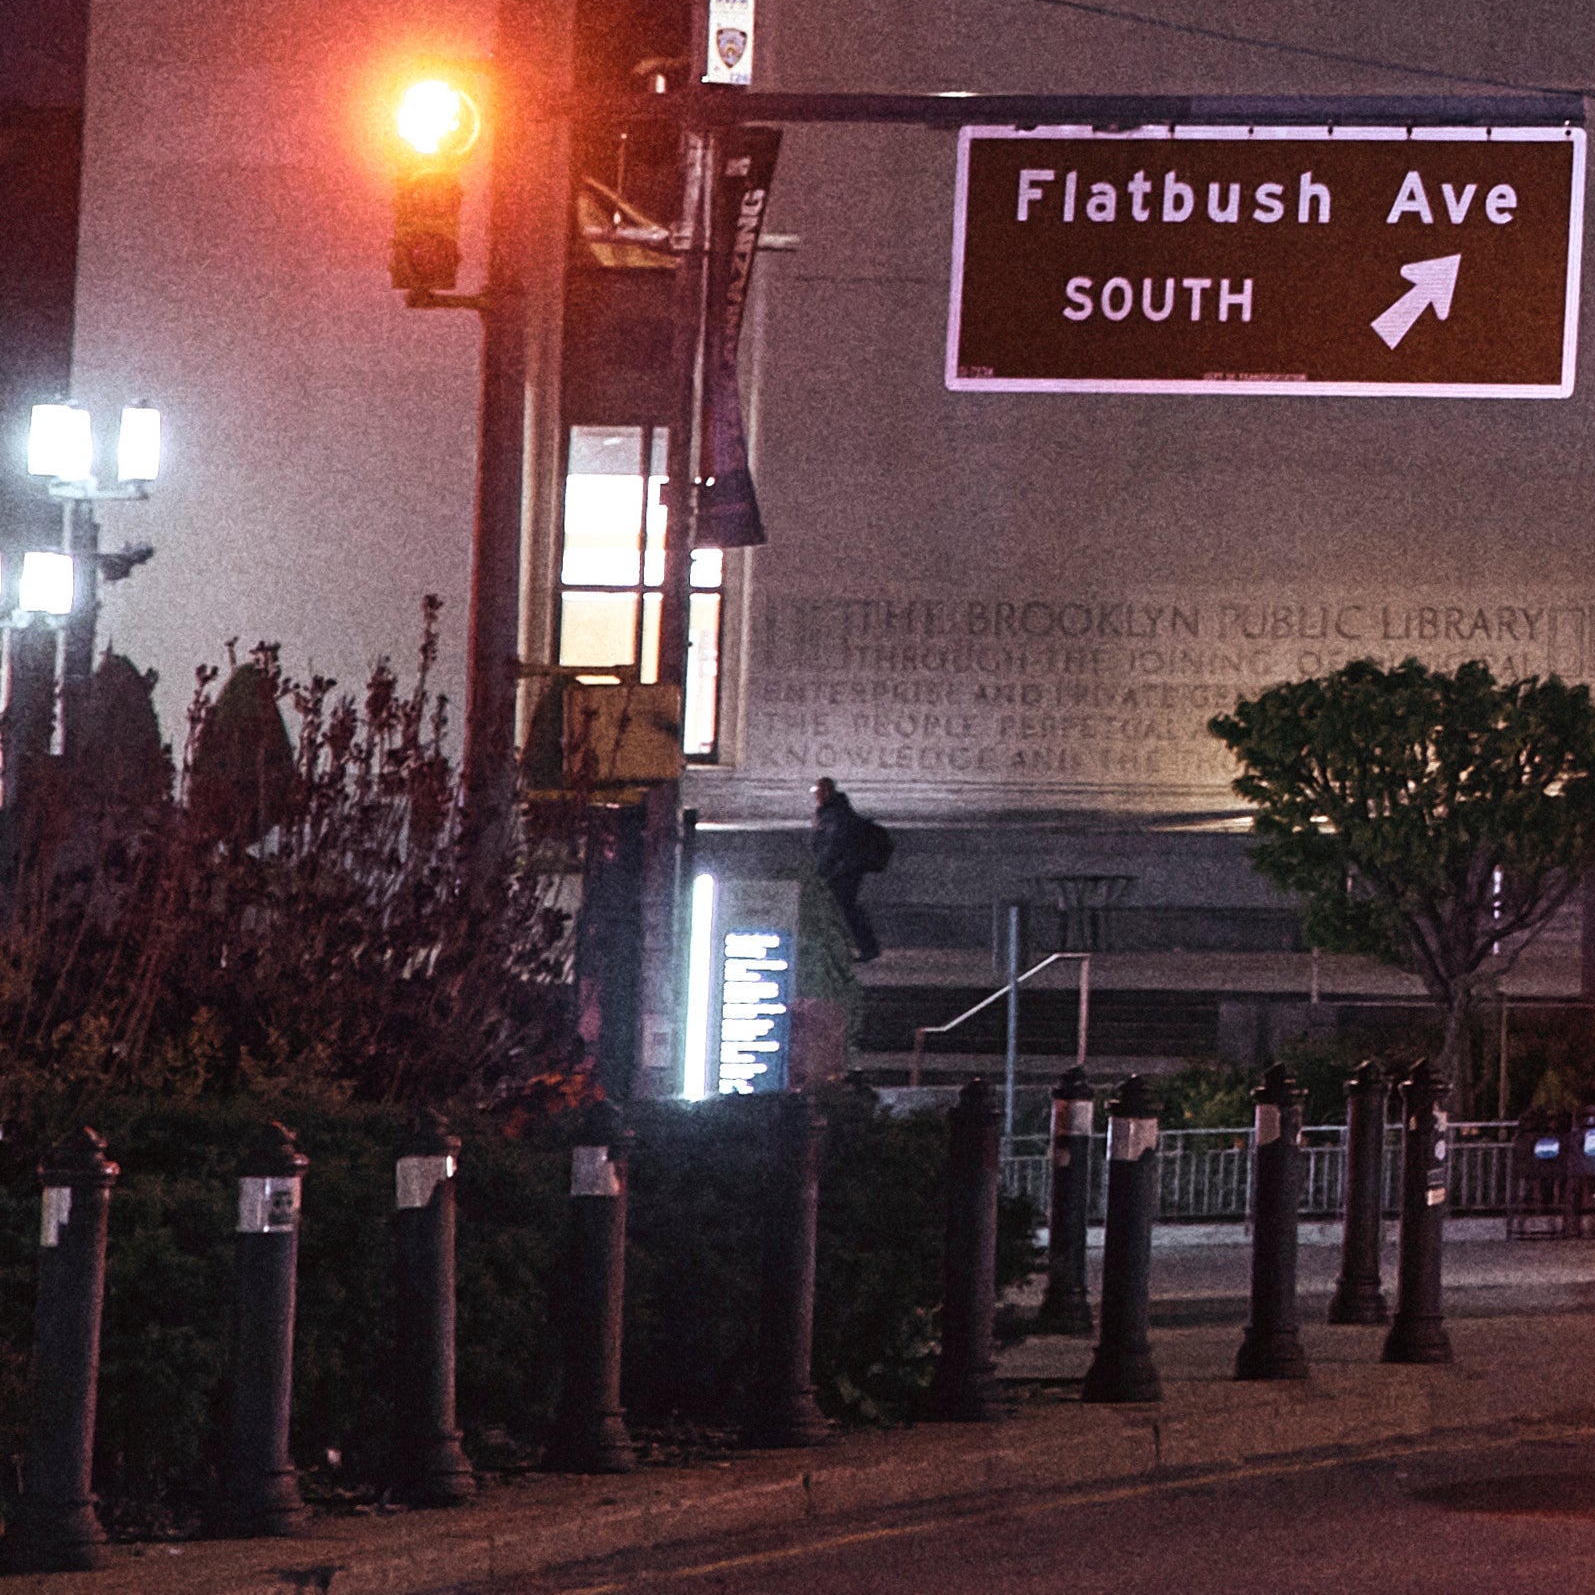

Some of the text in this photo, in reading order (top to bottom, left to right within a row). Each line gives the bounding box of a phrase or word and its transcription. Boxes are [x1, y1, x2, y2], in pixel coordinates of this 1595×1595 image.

[1016, 168, 1519, 225] Flatbush Ave
[1062, 275, 1255, 323] SOUTH
[967, 600, 1200, 640] BROOKLYN
[1219, 602, 1363, 641] PUBLIC
[1381, 604, 1544, 642] LIBRARY
